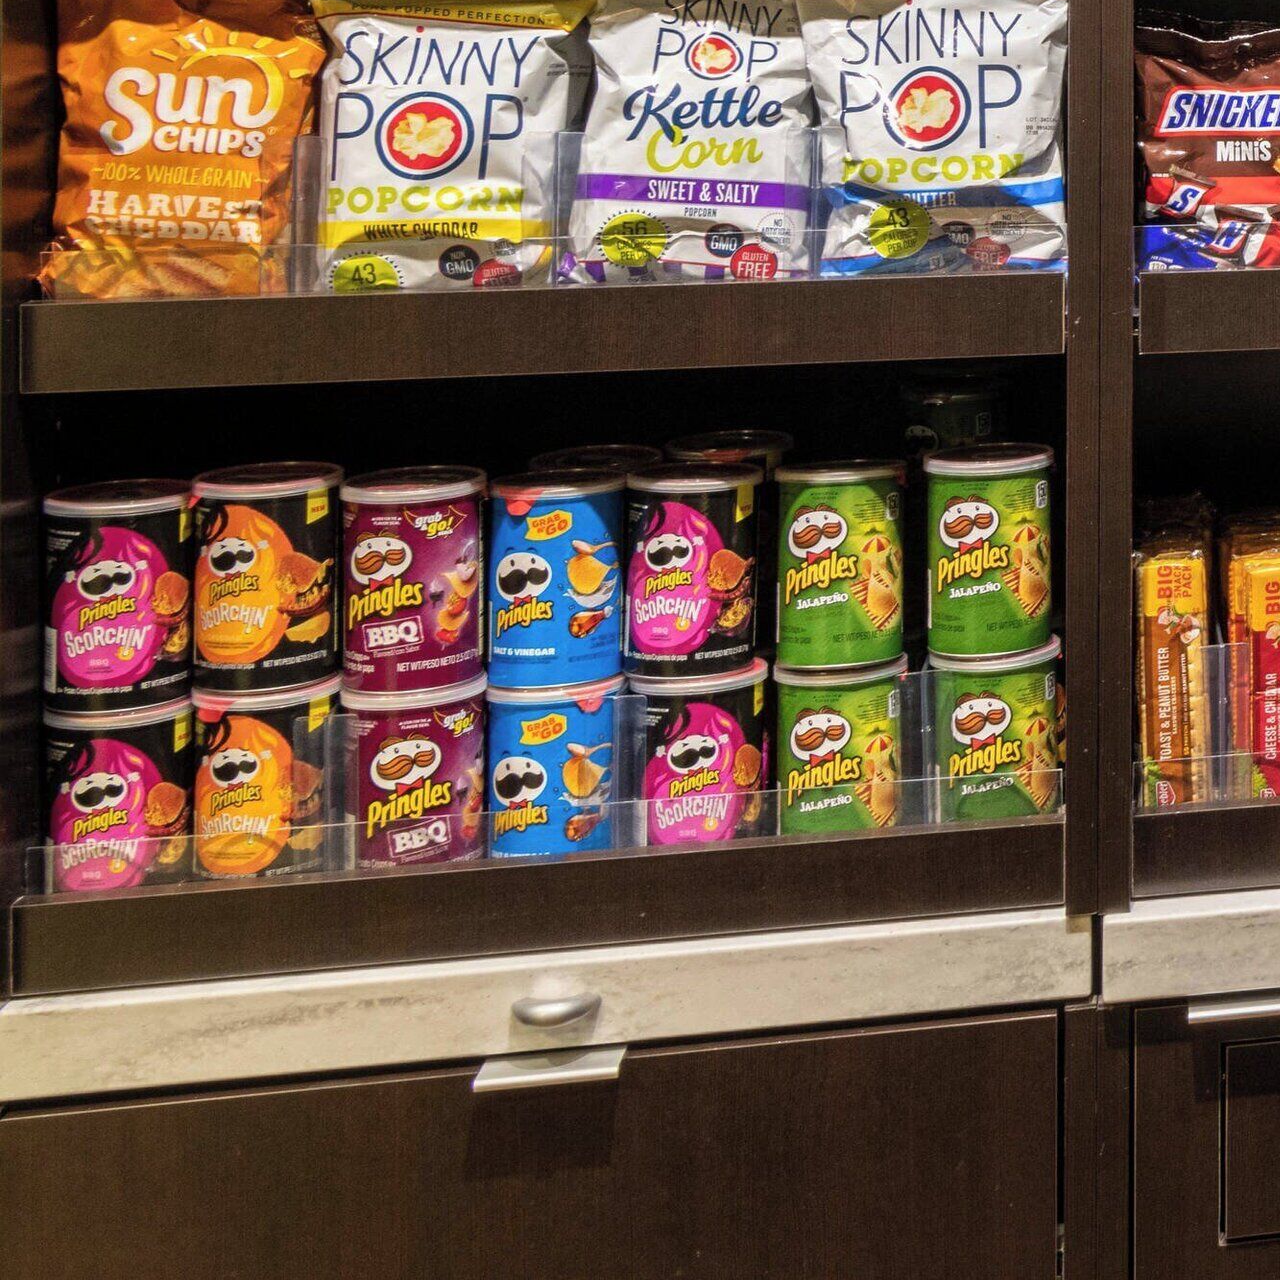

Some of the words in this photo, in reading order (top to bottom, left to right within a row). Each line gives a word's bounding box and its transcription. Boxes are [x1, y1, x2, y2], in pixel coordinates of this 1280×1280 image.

[458, 10, 545, 25] PERFECTION
[843, 3, 1023, 65] SKINNY
[341, 25, 539, 88] SKINNY
[653, 27, 776, 80] POP
[624, 83, 781, 141] Kettle
[841, 64, 1021, 162] POP
[155, 125, 265, 157] CHIPS
[331, 91, 523, 181] POP
[647, 127, 762, 172] Corn
[101, 164, 141, 182] 100%
[146, 166, 199, 185] WHOLE
[201, 168, 254, 189] GRAIN
[648, 180, 695, 200] SWEET
[699, 183, 711, 202] &
[716, 184, 759, 203] SALTY
[87, 190, 262, 218] HARVEST
[326, 186, 524, 214] POPCORN
[684, 207, 717, 217] POPCORN
[364, 224, 407, 240] WHITE
[887, 208, 910, 228] 43
[710, 236, 736, 250] GMO
[742, 252, 768, 261] GLUTEN
[353, 263, 376, 285] 43
[446, 259, 473, 273] GMO
[737, 261, 770, 278] FREE
[645, 568, 692, 598] Pringles
[785, 552, 858, 605] Pringles
[937, 544, 1010, 592] Pringles
[1157, 566, 1173, 598] BIG
[1182, 565, 1192, 597] PACK
[209, 575, 259, 604] Pringles
[348, 576, 424, 630] Pringles
[795, 592, 848, 611] JALAPEÑO
[949, 582, 1001, 600] JALAPEÑO
[1265, 581, 1280, 614] BIG
[79, 597, 136, 629] Pringles
[496, 598, 553, 638] Pringles
[367, 621, 420, 649] BBQ
[1158, 647, 1170, 678] BUTTER
[1159, 681, 1171, 716] PEANUT
[1160, 733, 1172, 760] TOAST
[1265, 721, 1276, 760] CHEESE
